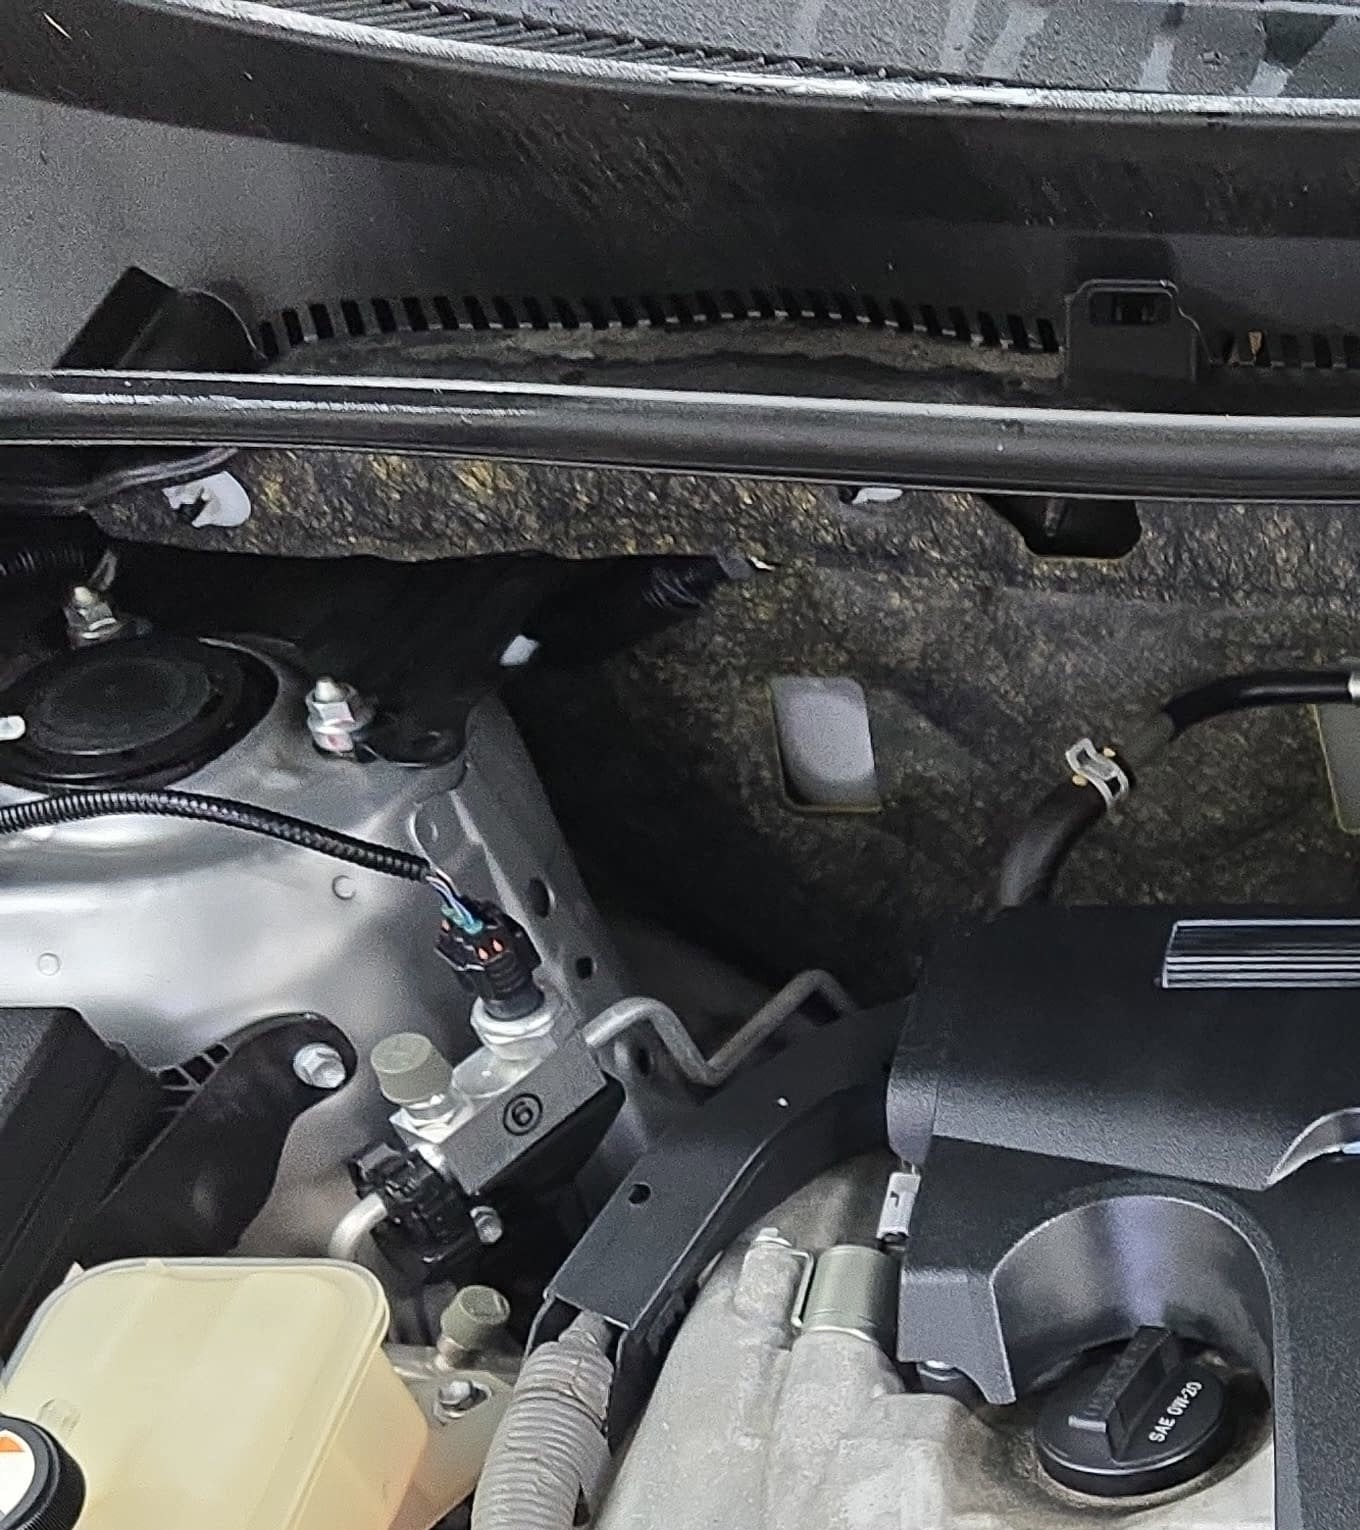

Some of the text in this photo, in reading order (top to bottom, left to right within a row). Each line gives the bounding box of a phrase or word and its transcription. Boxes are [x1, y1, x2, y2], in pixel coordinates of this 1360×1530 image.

[512, 1101, 534, 1126] 6
[1148, 1382, 1203, 1442] SAE 0W-20
